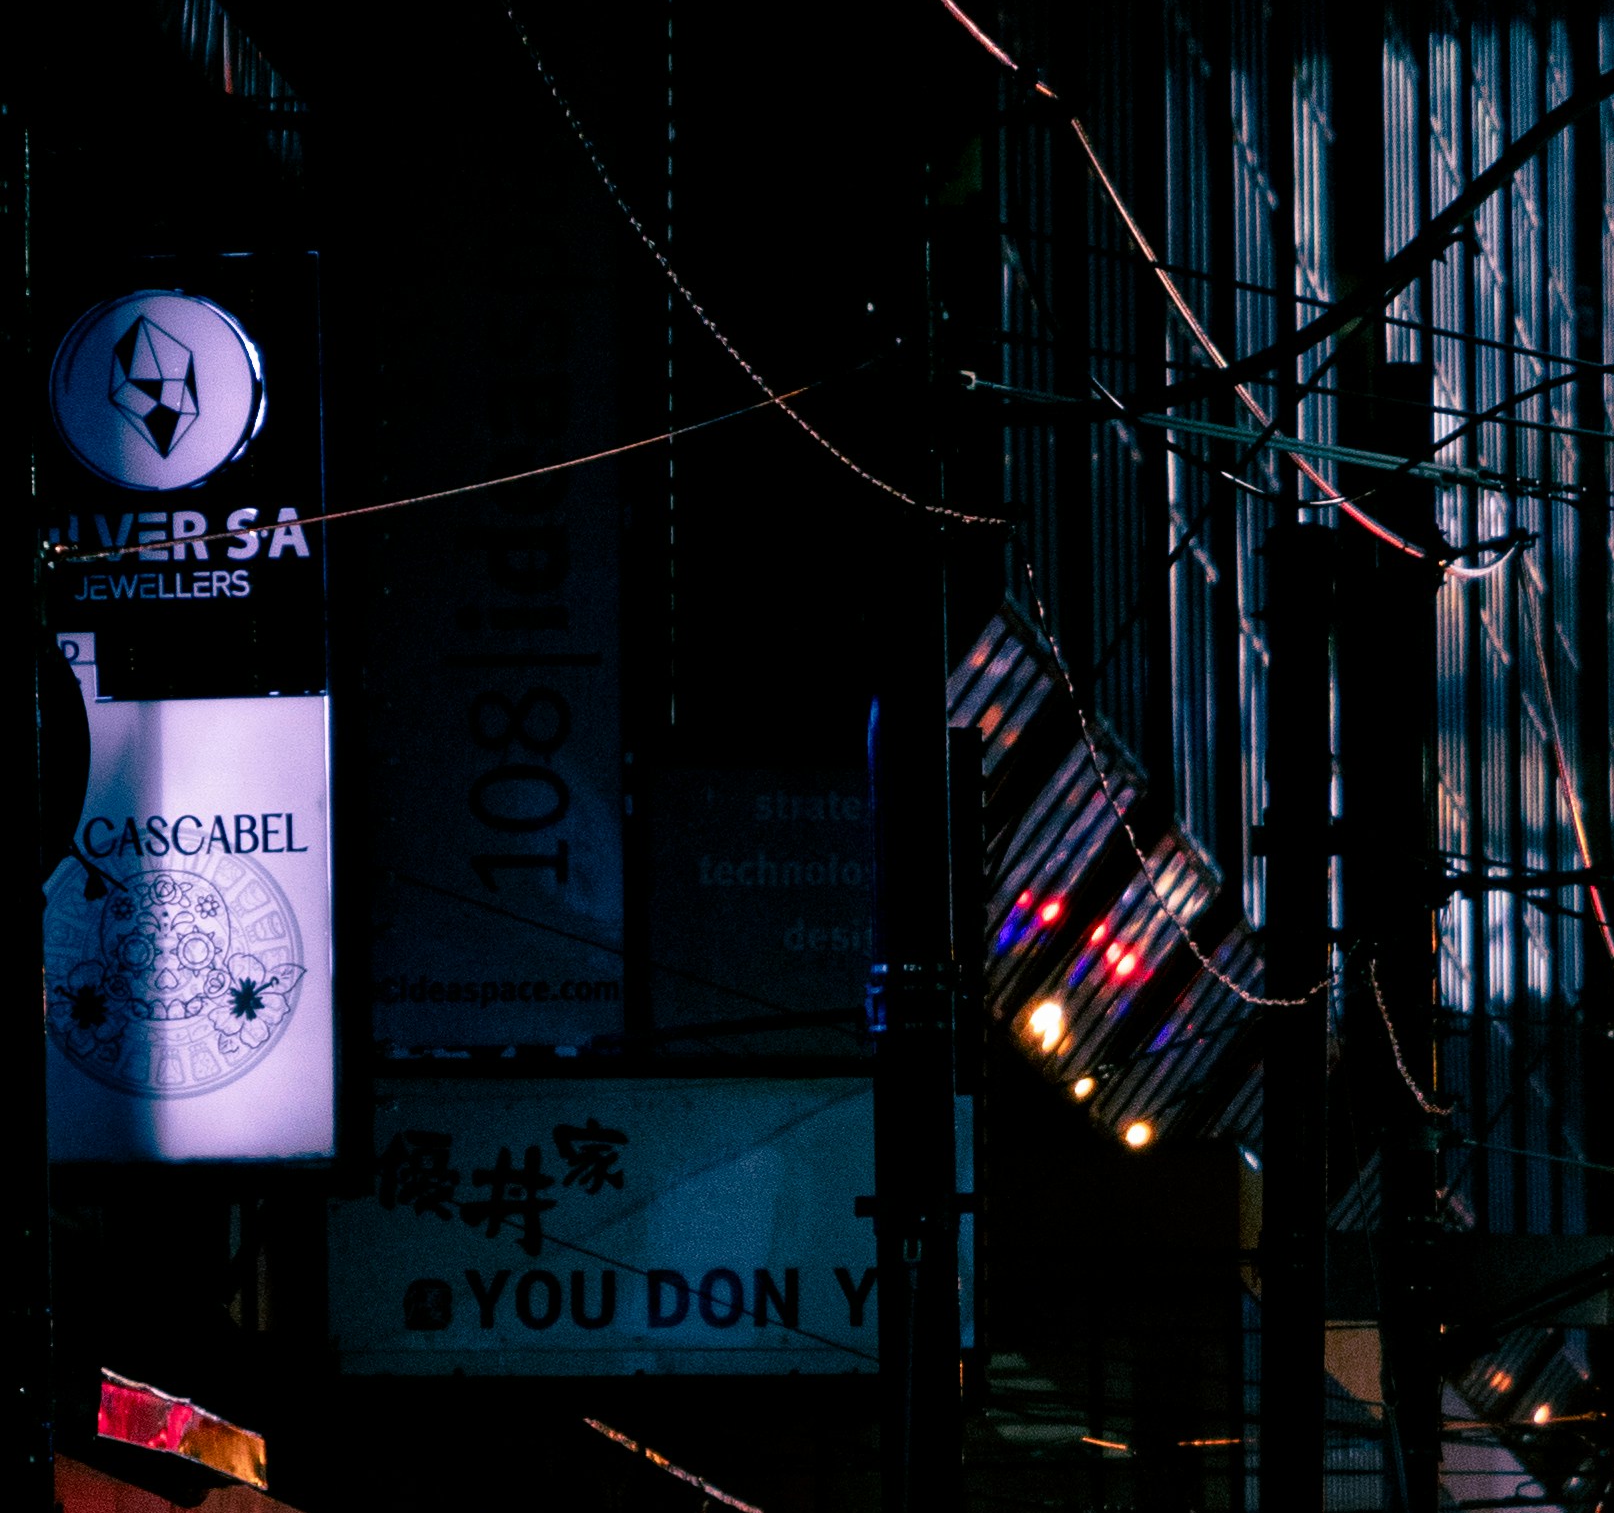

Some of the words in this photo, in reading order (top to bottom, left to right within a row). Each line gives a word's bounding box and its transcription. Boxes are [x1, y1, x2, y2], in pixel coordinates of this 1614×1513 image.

[74, 568, 251, 601] JEWELLERS
[83, 812, 309, 858] CASCABEL
[465, 1269, 617, 1328] YOU
[647, 1269, 799, 1328] DON
[833, 1268, 880, 1327] Y
